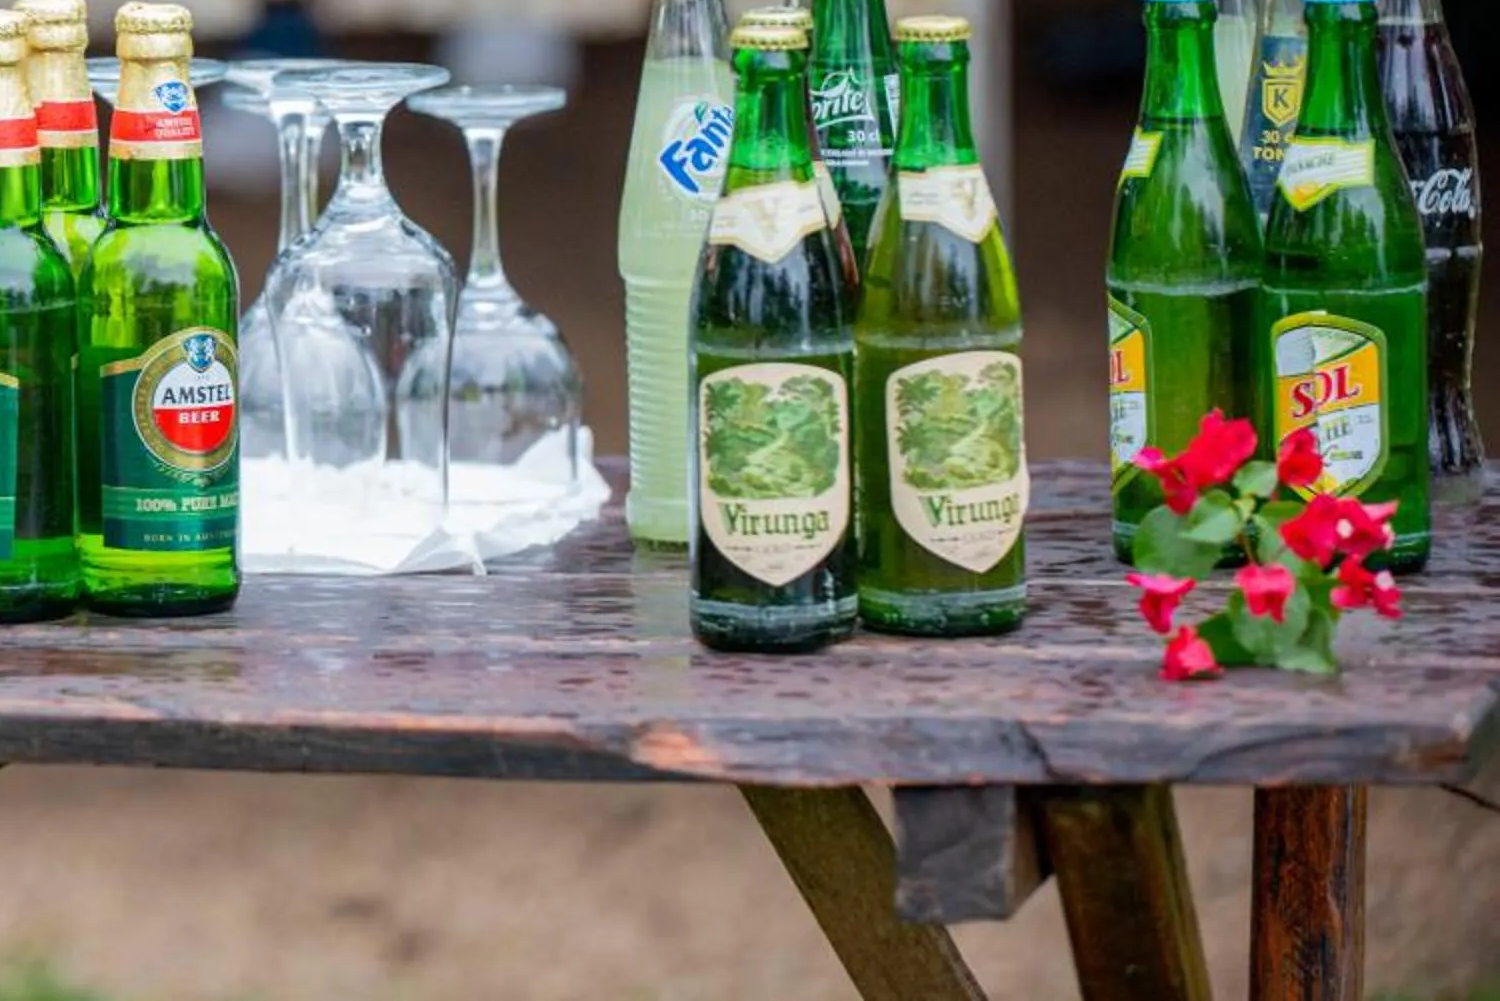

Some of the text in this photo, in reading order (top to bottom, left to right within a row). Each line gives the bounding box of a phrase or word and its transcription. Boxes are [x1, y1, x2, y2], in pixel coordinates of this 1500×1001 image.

[810, 89, 863, 120] prite
[1274, 88, 1289, 108] K
[847, 130, 865, 143] 30
[1252, 147, 1284, 162] TON
[161, 382, 231, 406] AMSTEL
[179, 410, 221, 425] BEER
[135, 497, 177, 512] 100%
[181, 495, 218, 512] PURE
[718, 501, 830, 540] Virunga
